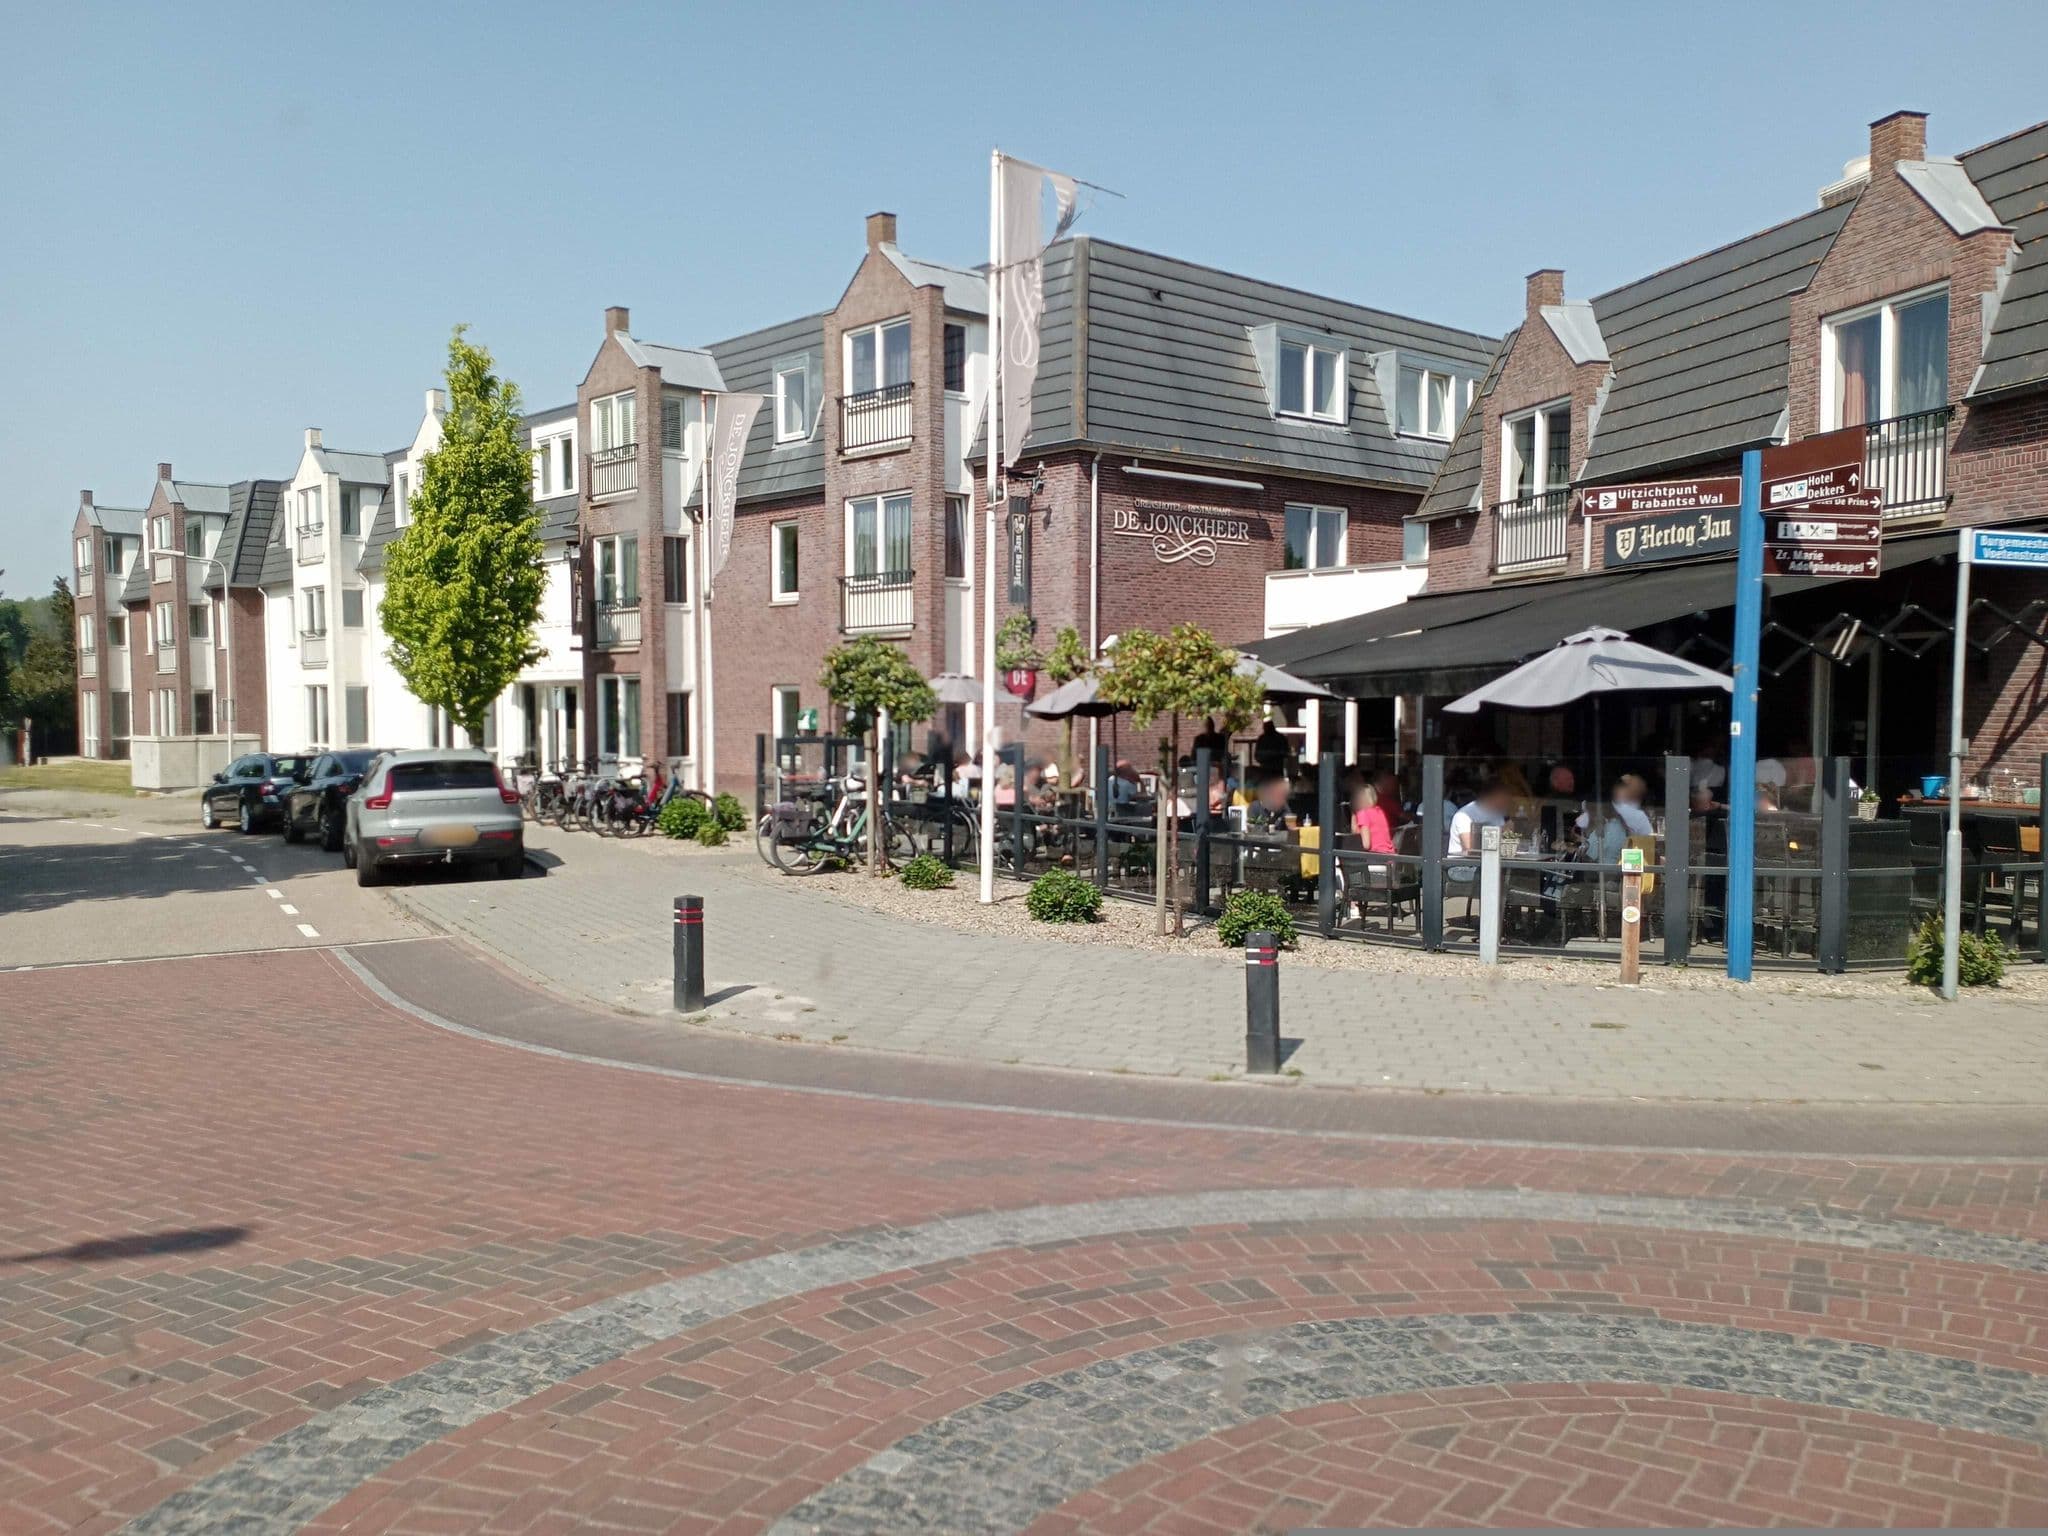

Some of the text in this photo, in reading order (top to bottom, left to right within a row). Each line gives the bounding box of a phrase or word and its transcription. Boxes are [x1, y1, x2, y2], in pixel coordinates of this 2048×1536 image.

[1808, 472, 1833, 486] Hotel
[1618, 485, 1698, 500] Uitzichtpunt
[1807, 485, 1845, 500] Dekkers
[1632, 493, 1723, 509] Brabantse Wal
[1847, 497, 1869, 506] Prins
[1113, 509, 1249, 541] DE JONCKHEER
[1639, 514, 1731, 557] Hertog Jan
[1793, 550, 1824, 561] Marie
